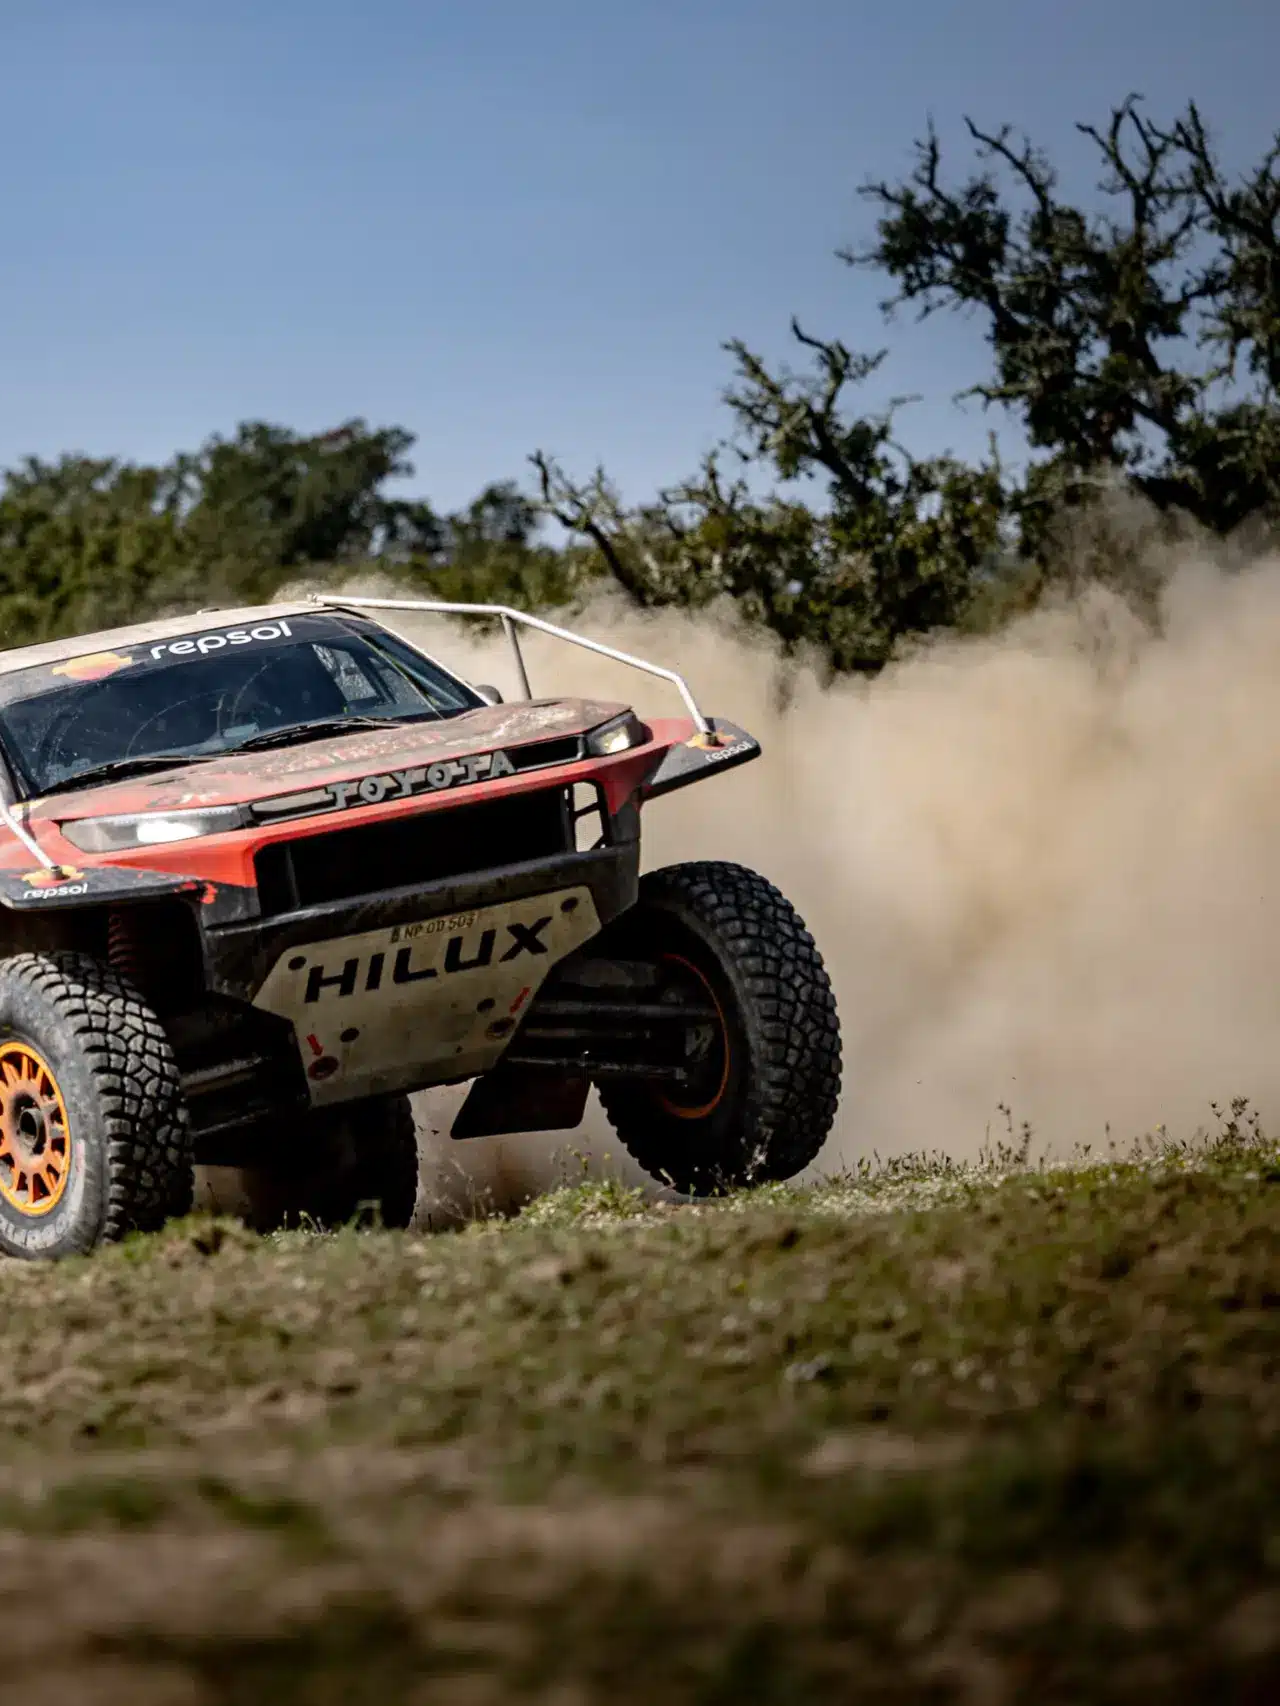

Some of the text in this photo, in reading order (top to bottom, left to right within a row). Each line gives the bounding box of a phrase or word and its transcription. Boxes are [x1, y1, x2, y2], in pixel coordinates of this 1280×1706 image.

[150, 620, 292, 660] repsol
[705, 740, 752, 762] repsol
[326, 750, 517, 809] TOYOTA
[23, 882, 88, 899] repsol
[304, 916, 553, 1004] HILUX
